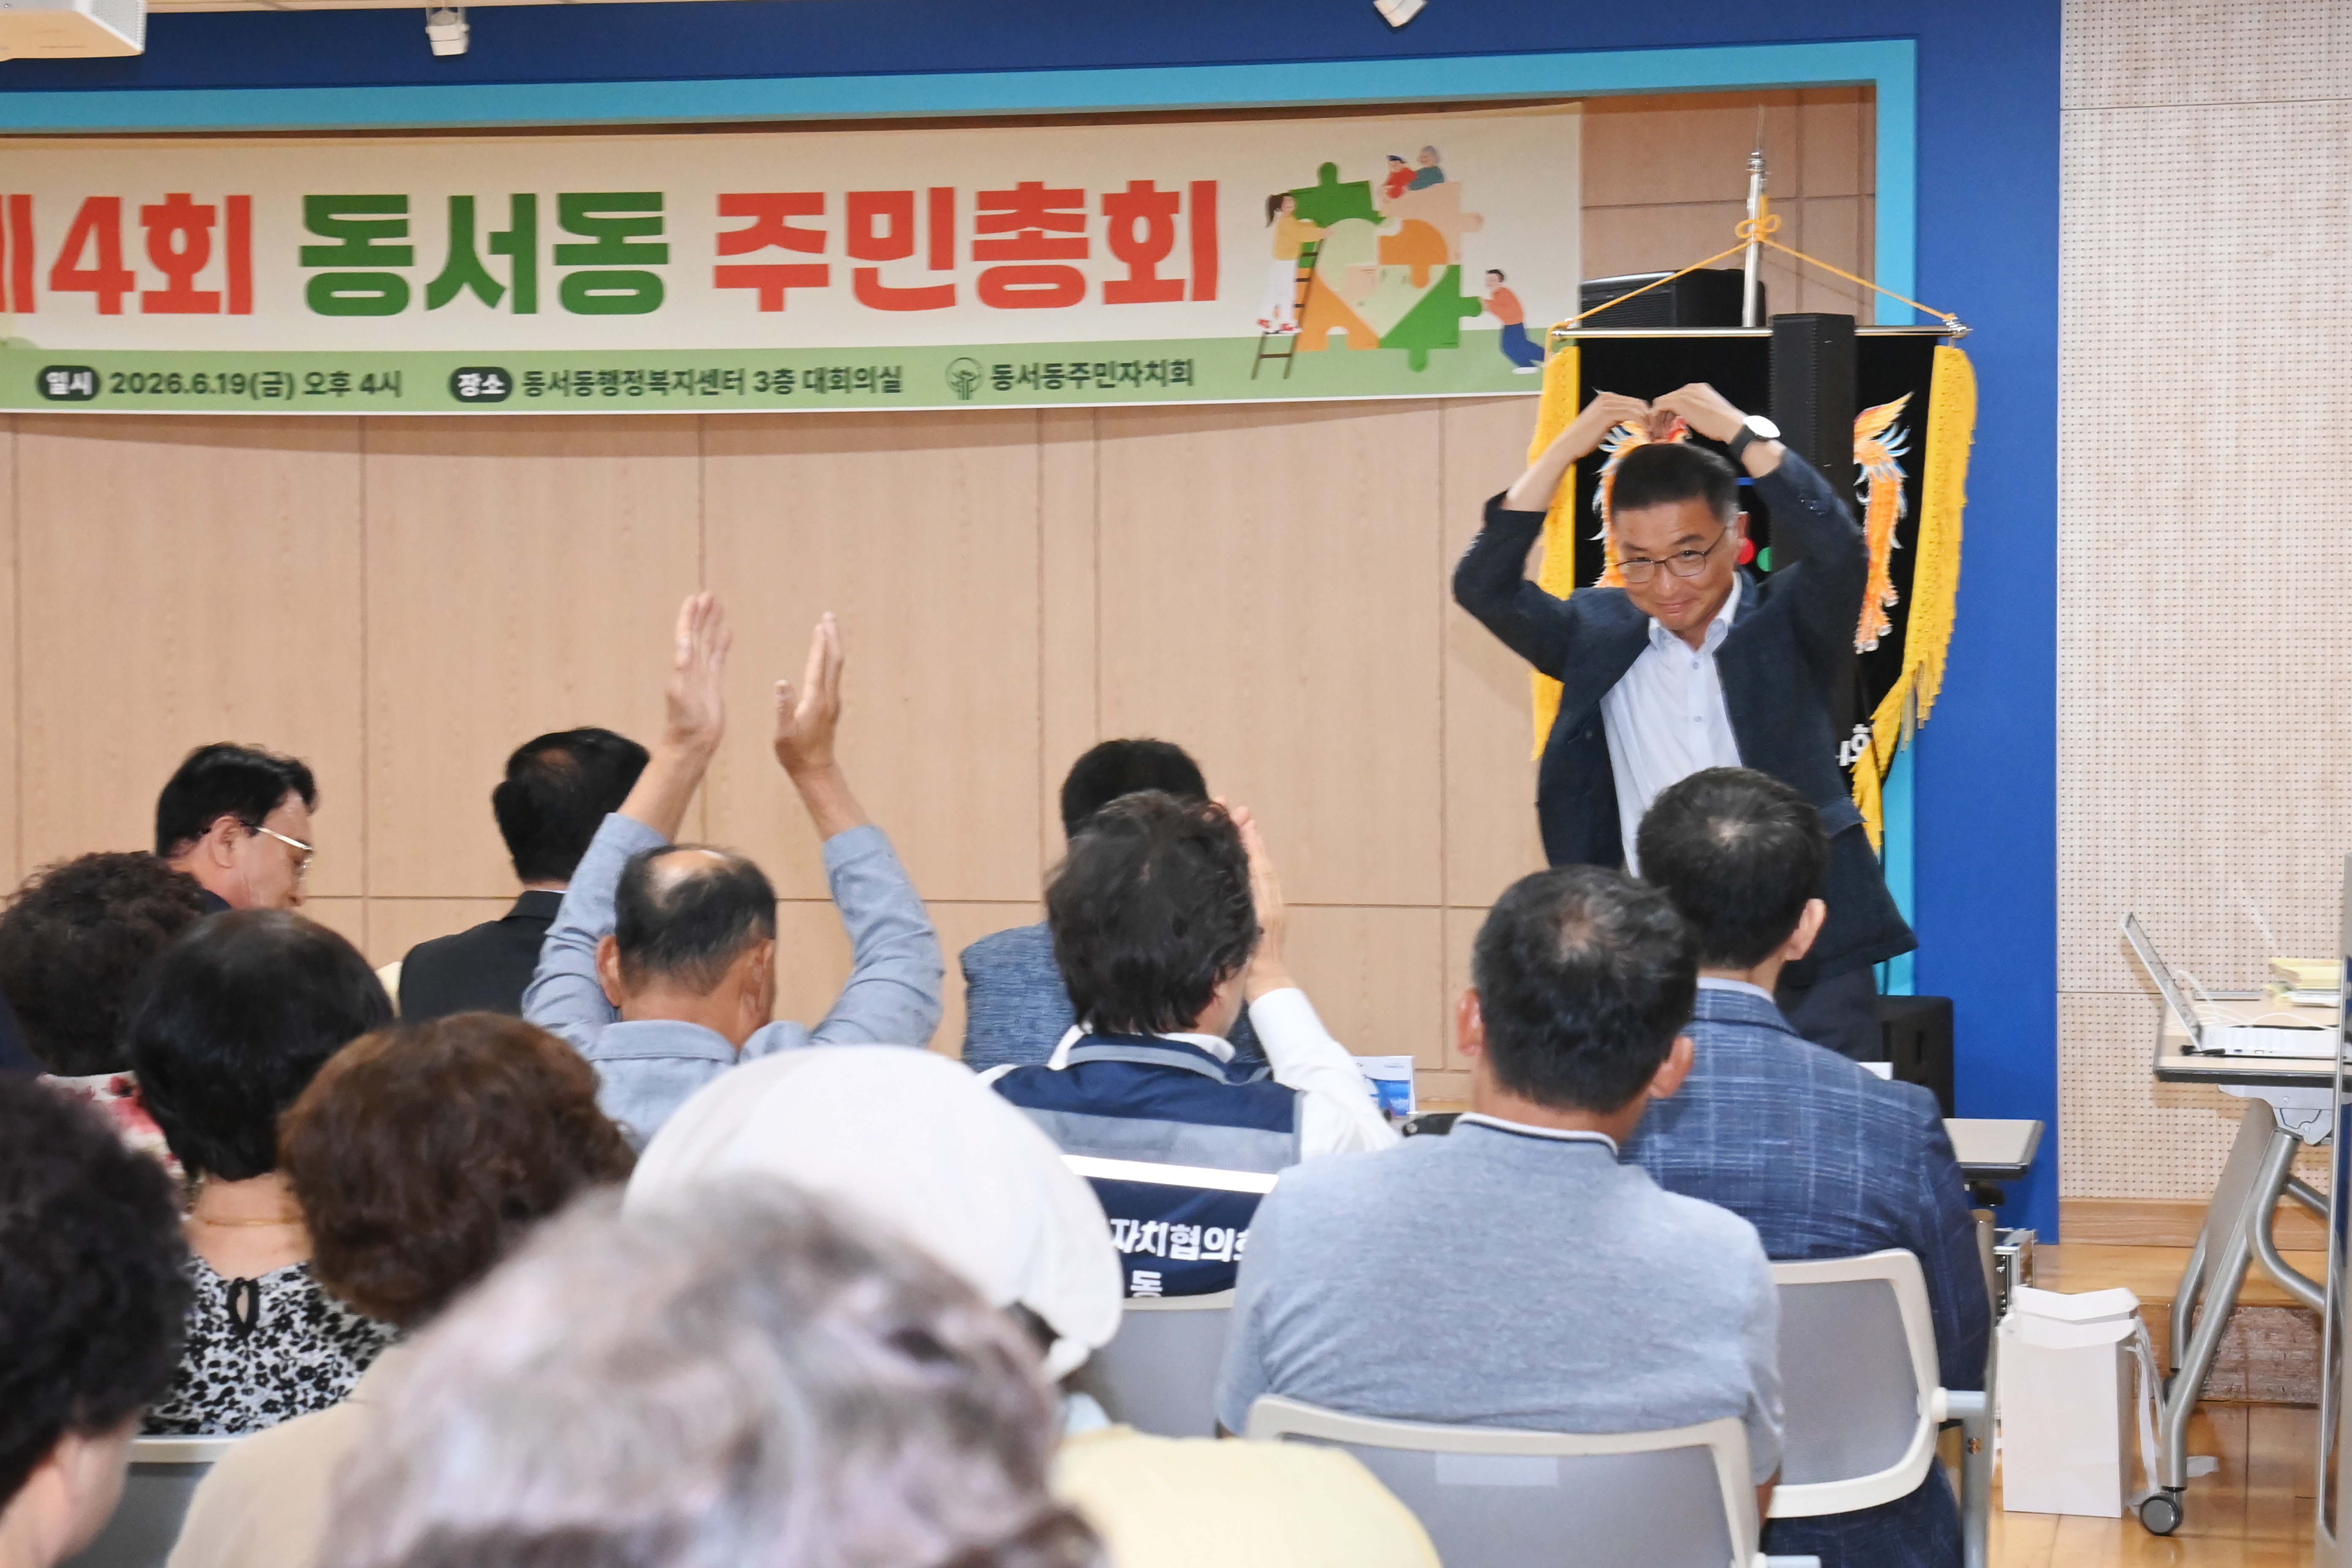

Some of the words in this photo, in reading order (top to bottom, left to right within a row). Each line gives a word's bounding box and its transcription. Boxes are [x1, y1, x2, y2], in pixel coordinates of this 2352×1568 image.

[299, 191, 670, 316] 동서동
[713, 180, 1218, 312] 주민총회
[46, 371, 93, 396] 일시
[110, 371, 294, 400] 2026.6.19(금)
[302, 370, 352, 398] 오후
[359, 370, 403, 398] 4시
[457, 373, 506, 397] 장소
[521, 368, 745, 397] 동서동행정복지센터
[753, 368, 795, 395] 3층
[803, 365, 902, 395] 대회의실
[991, 358, 1195, 391] 동서동주민자치회
